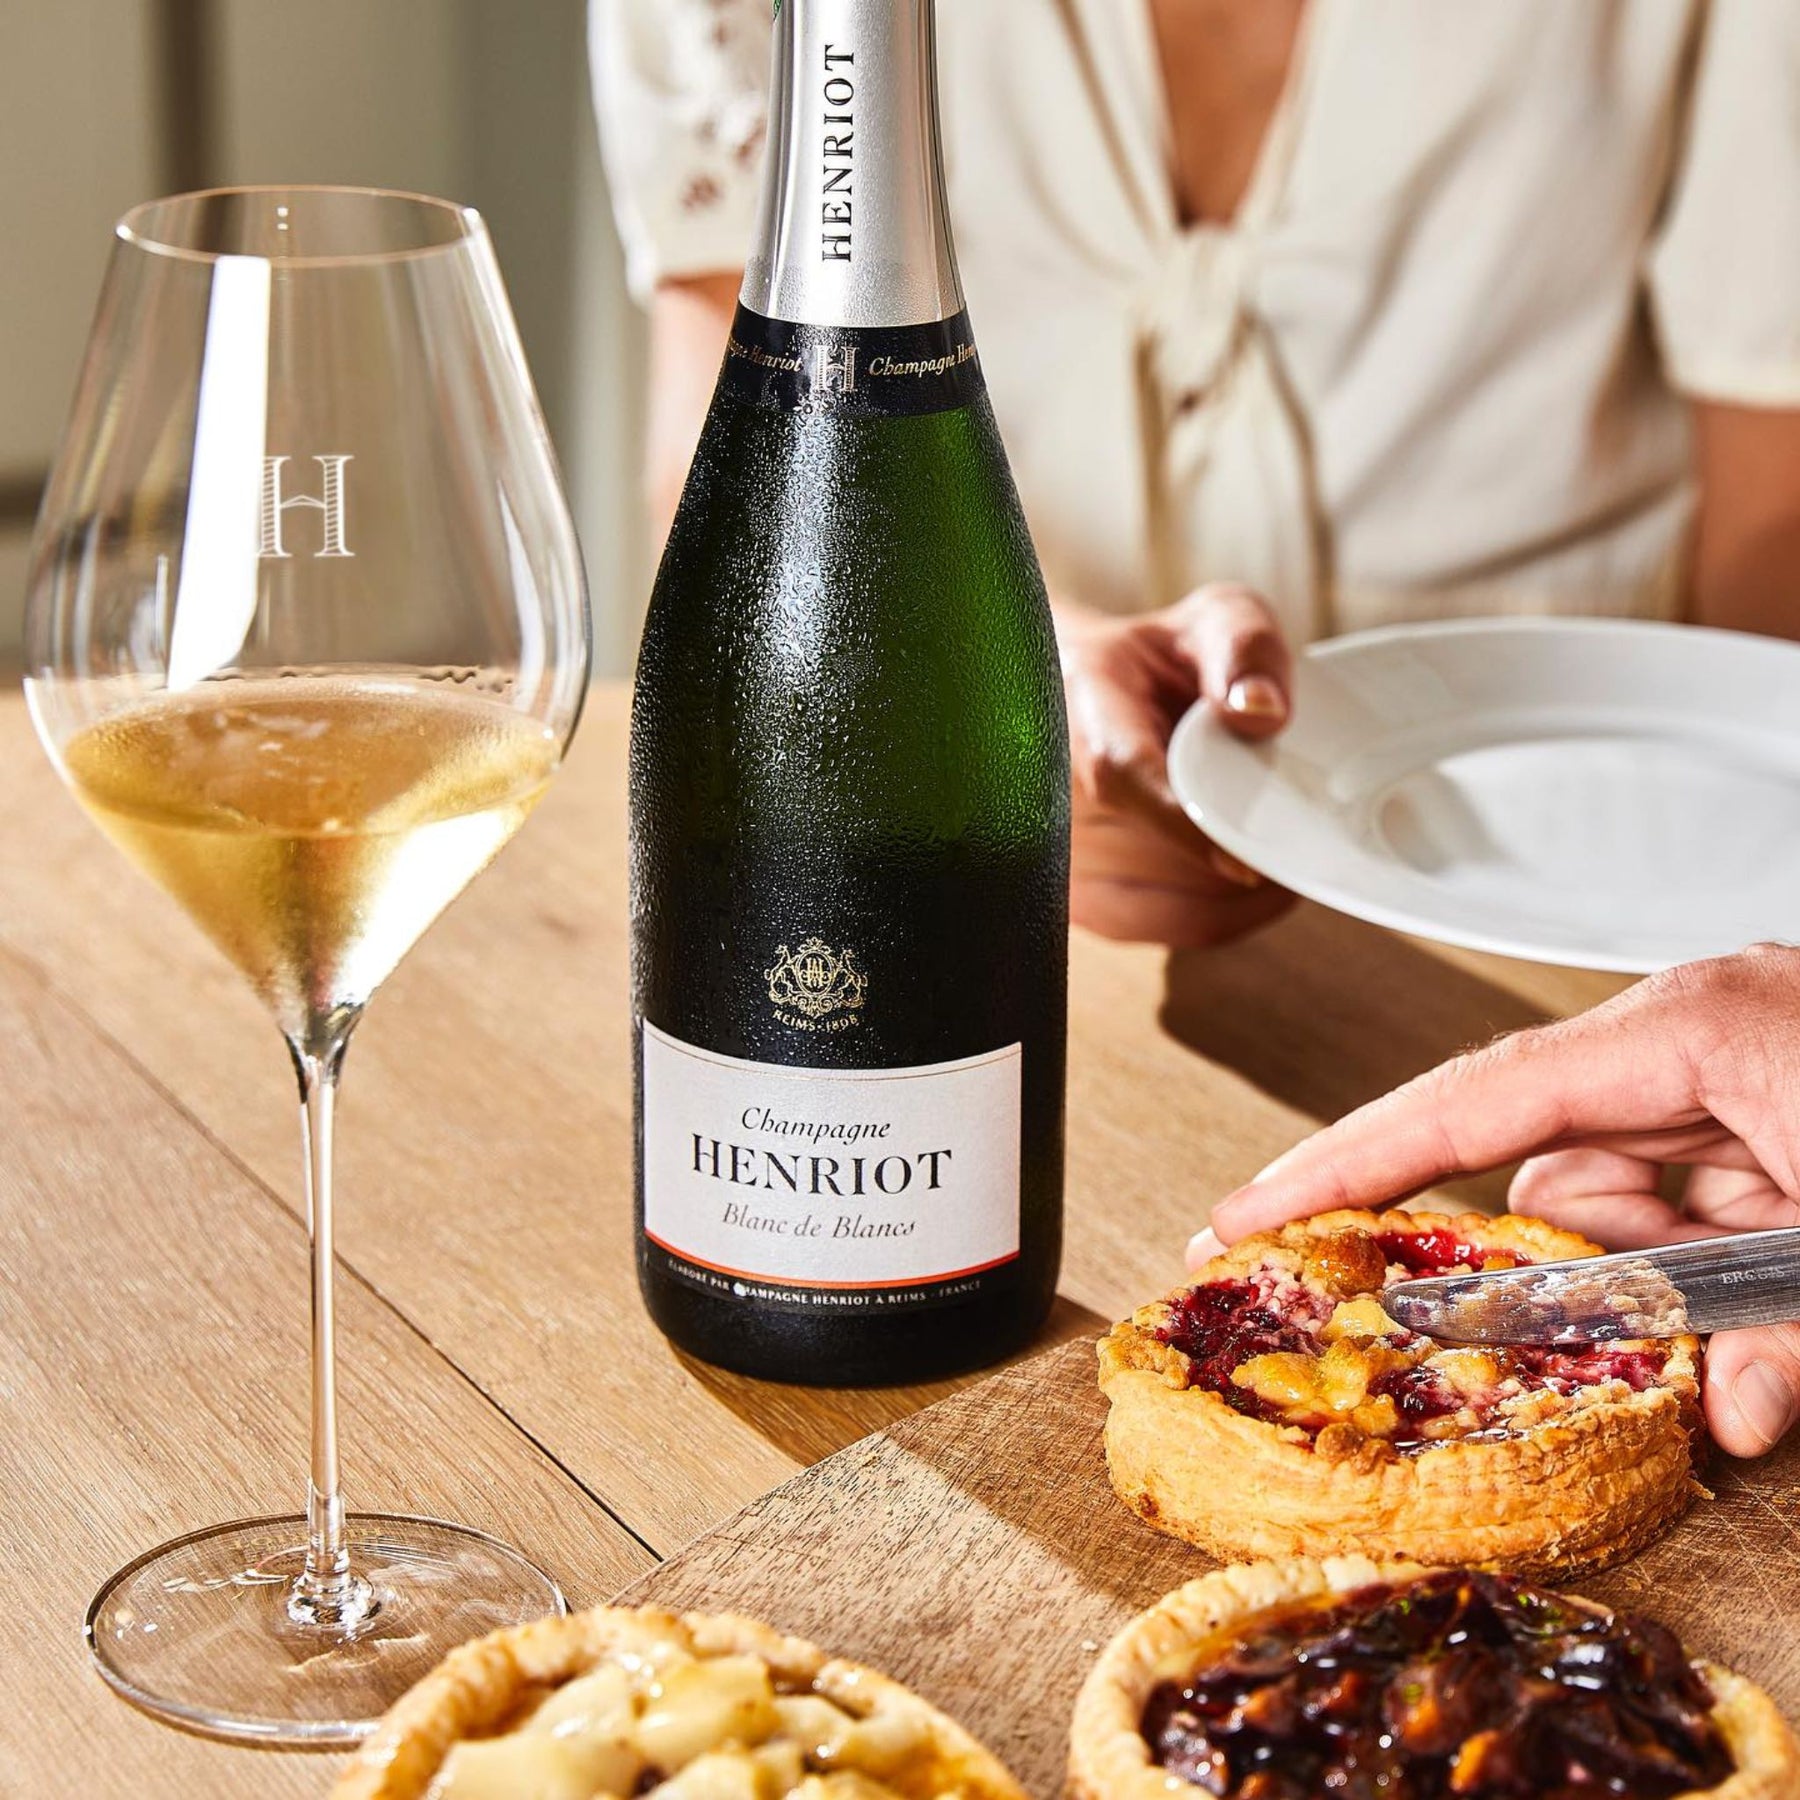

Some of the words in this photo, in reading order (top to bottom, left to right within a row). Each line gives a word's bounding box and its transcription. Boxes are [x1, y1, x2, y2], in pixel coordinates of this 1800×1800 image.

[822, 44, 854, 262] HENRIOT
[815, 345, 858, 393] H
[869, 354, 956, 378] Champagne
[256, 455, 355, 557] H
[772, 1009, 815, 1032] REIMS
[741, 1106, 891, 1146] Champagne
[692, 1133, 952, 1196] HENRIOT
[722, 1202, 788, 1234] Blanc
[794, 1214, 822, 1238] de
[832, 1215, 916, 1239] Blancs
[711, 1276, 729, 1291] PAR
[812, 1294, 870, 1305] HENRIOT
[888, 1292, 926, 1304] REIMS
[939, 1279, 981, 1298] FRANCE
